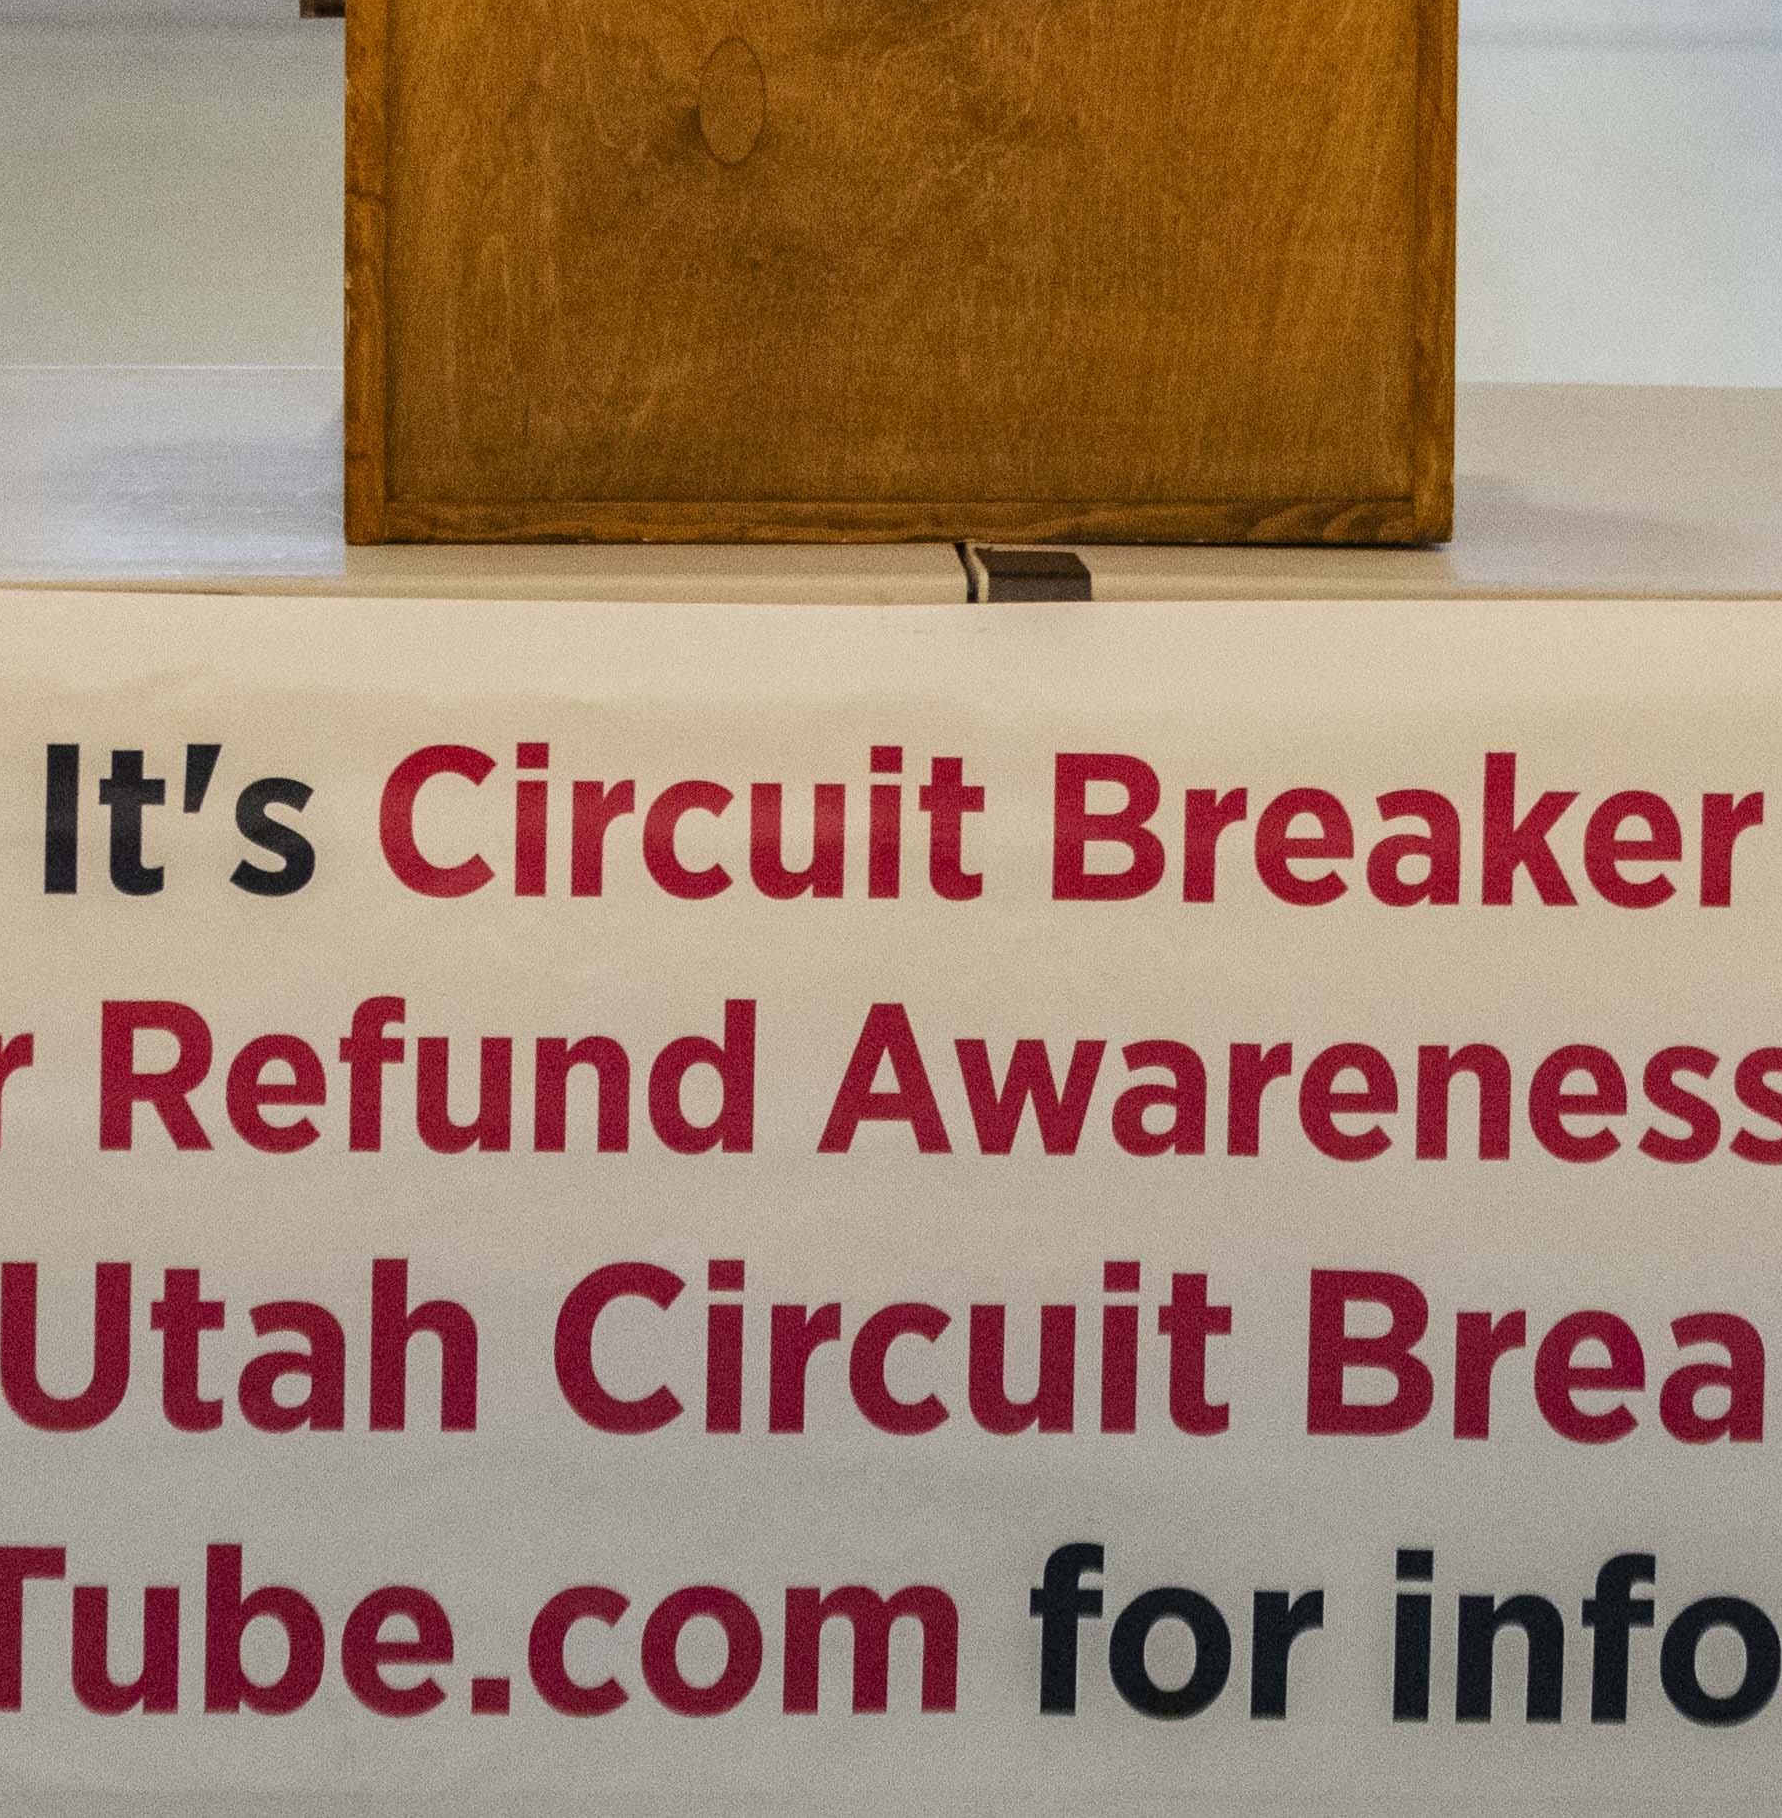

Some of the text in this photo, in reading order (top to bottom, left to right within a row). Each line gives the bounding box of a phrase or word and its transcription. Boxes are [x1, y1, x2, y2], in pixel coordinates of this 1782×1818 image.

[43, 741, 316, 898] It's
[379, 742, 987, 901] Circuit
[1051, 751, 1765, 909] Breaker
[98, 998, 757, 1155] Refund
[553, 1258, 1234, 1437] Circuit
[1028, 1541, 1326, 1722] for
